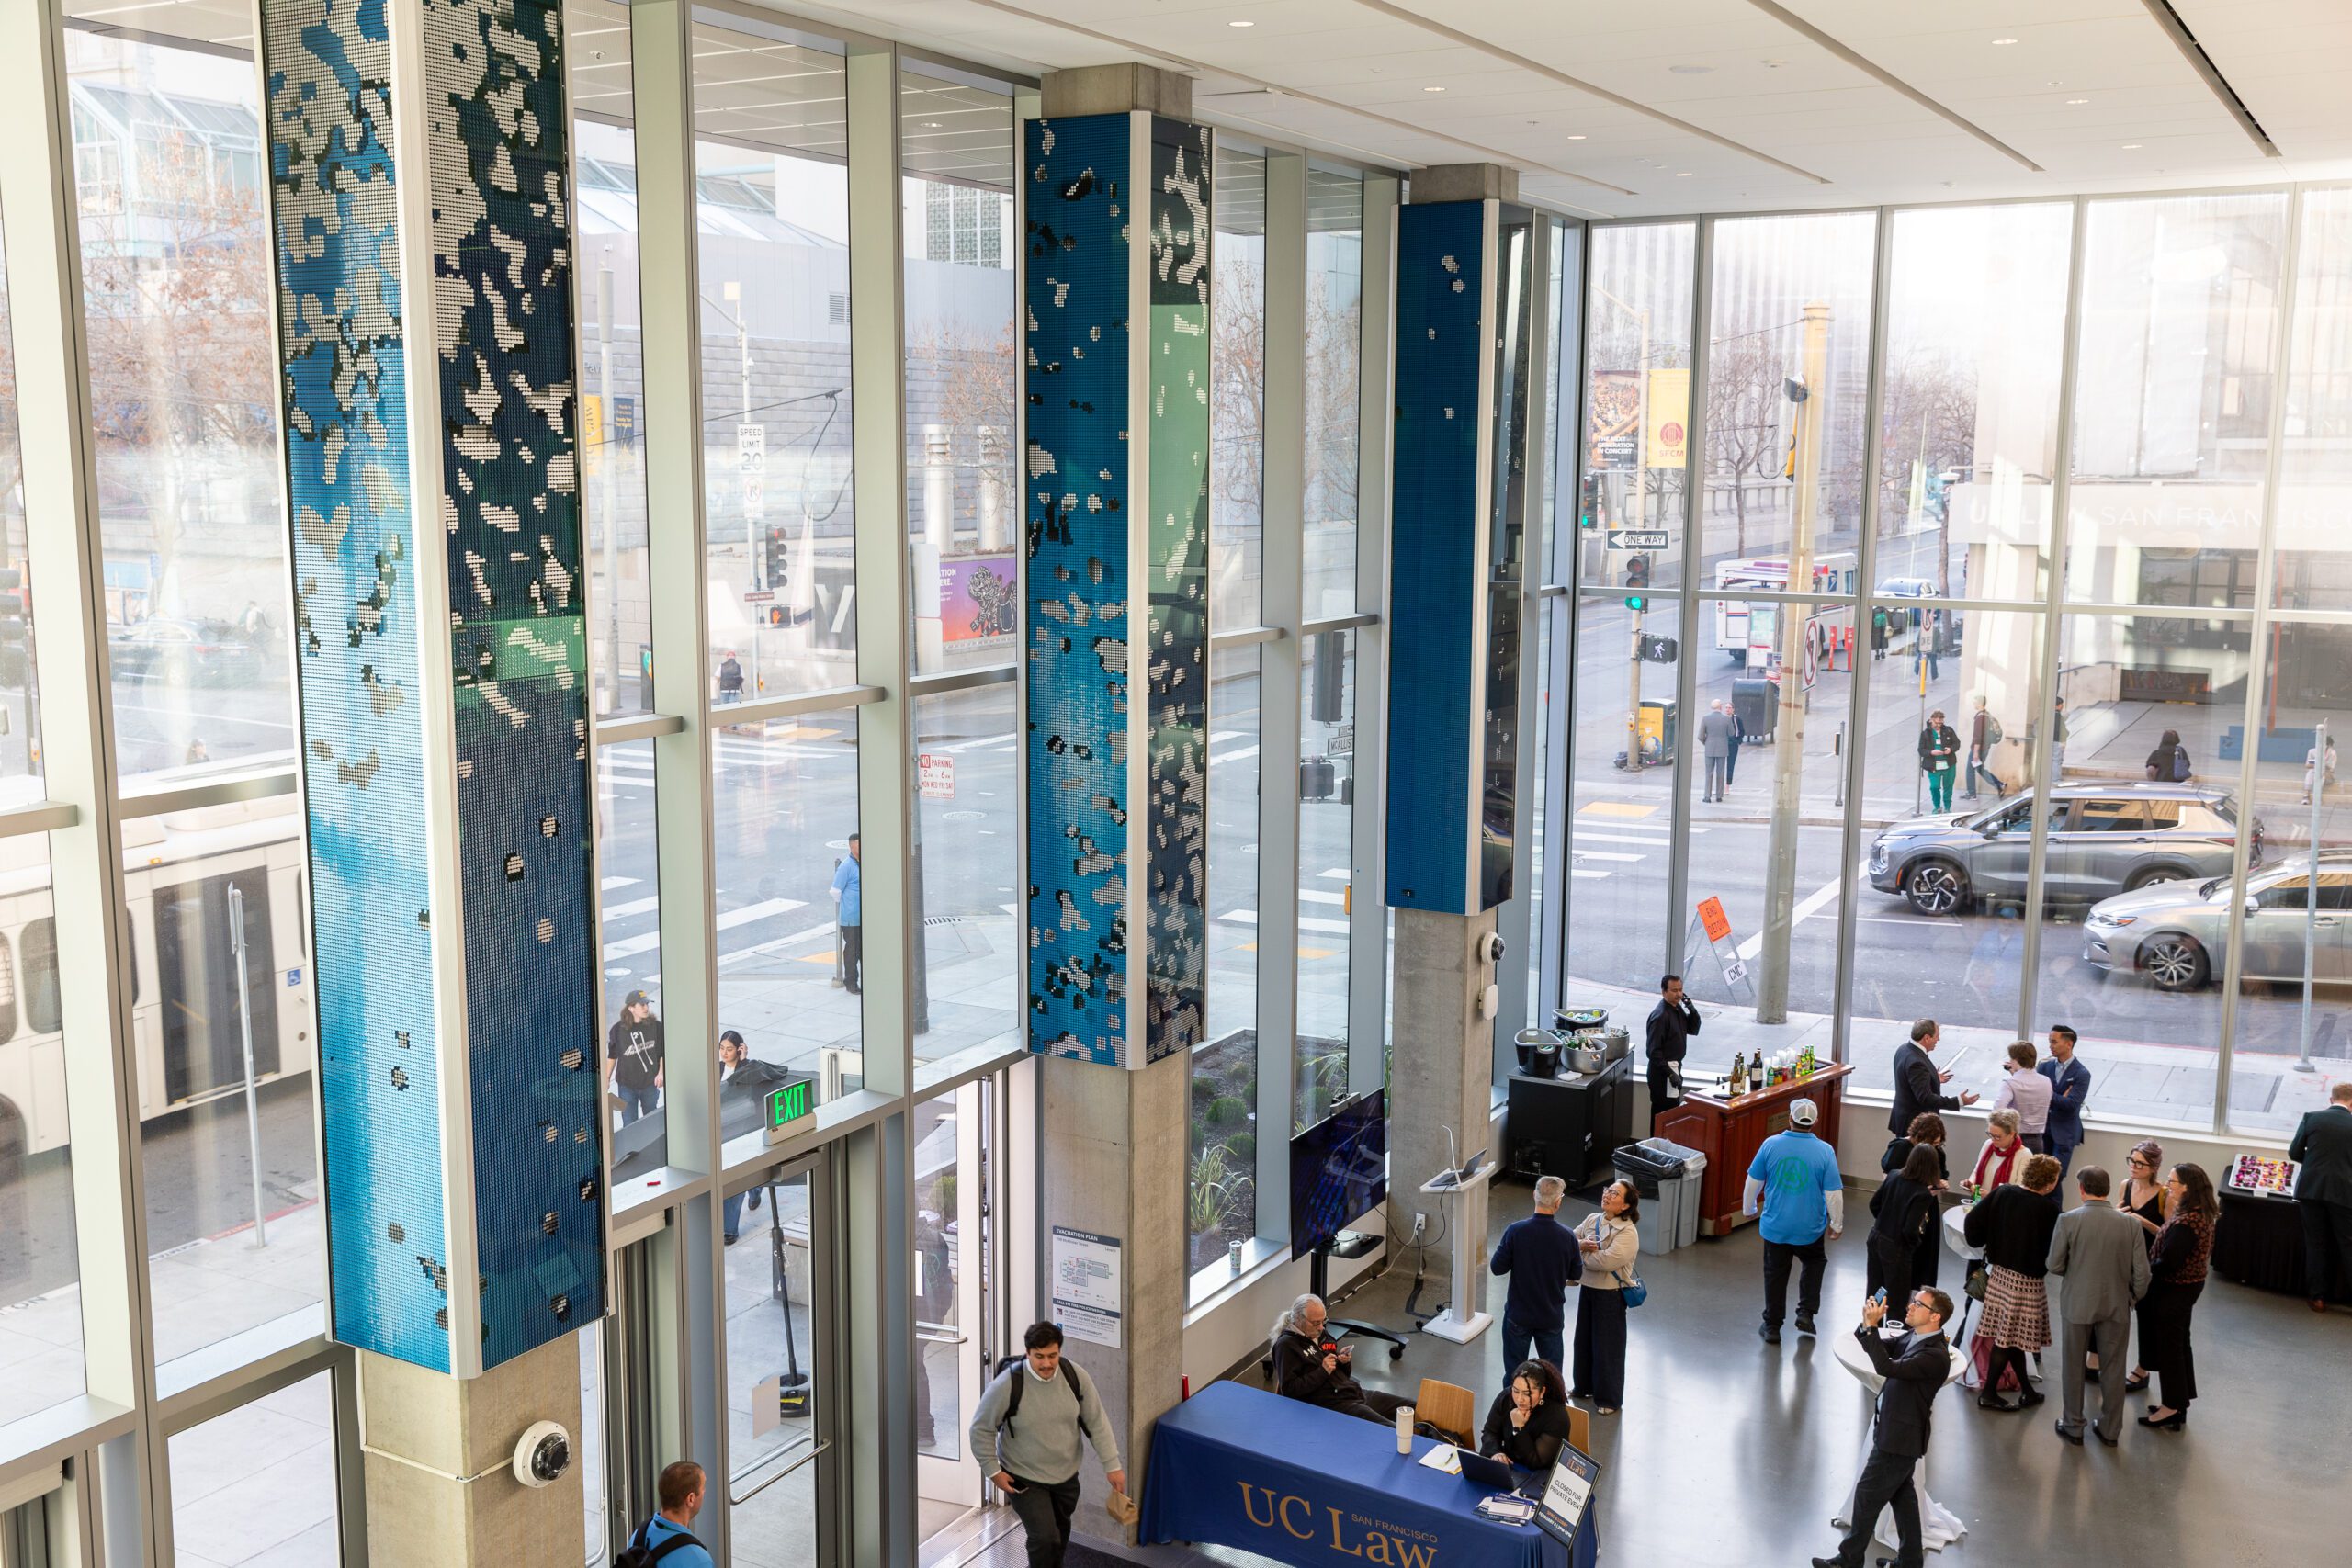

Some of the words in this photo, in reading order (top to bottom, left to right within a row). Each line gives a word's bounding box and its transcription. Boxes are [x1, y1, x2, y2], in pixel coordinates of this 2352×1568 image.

[740, 428, 763, 436] SPEED
[741, 440, 761, 449] LIMIT
[1659, 449, 1684, 457] SFCM
[741, 452, 763, 471] 20
[2101, 507, 2165, 526] SAN
[1624, 536, 1642, 544] ONE
[1645, 536, 1663, 544] WAY
[940, 568, 956, 577] TION
[940, 578, 953, 586] ERE.
[921, 755, 930, 768] NO
[932, 759, 953, 769] PARKING
[1707, 918, 1727, 935] DETOUR
[1728, 964, 1743, 981] CMC
[775, 1083, 806, 1125] EXIT
[1056, 1228, 1085, 1239] EVACUATION
[1085, 1234, 1099, 1242] PLAN
[1549, 1485, 1567, 1502] PRIVATE
[1567, 1497, 1582, 1511] EVENT
[1555, 1479, 1572, 1496] CLOSED
[1572, 1492, 1582, 1503] FOR
[1237, 1481, 1315, 1540] UC
[1326, 1506, 1438, 1568] Law
[1351, 1513, 1372, 1527] SAN
[1375, 1519, 1439, 1544] FRANCISCO
